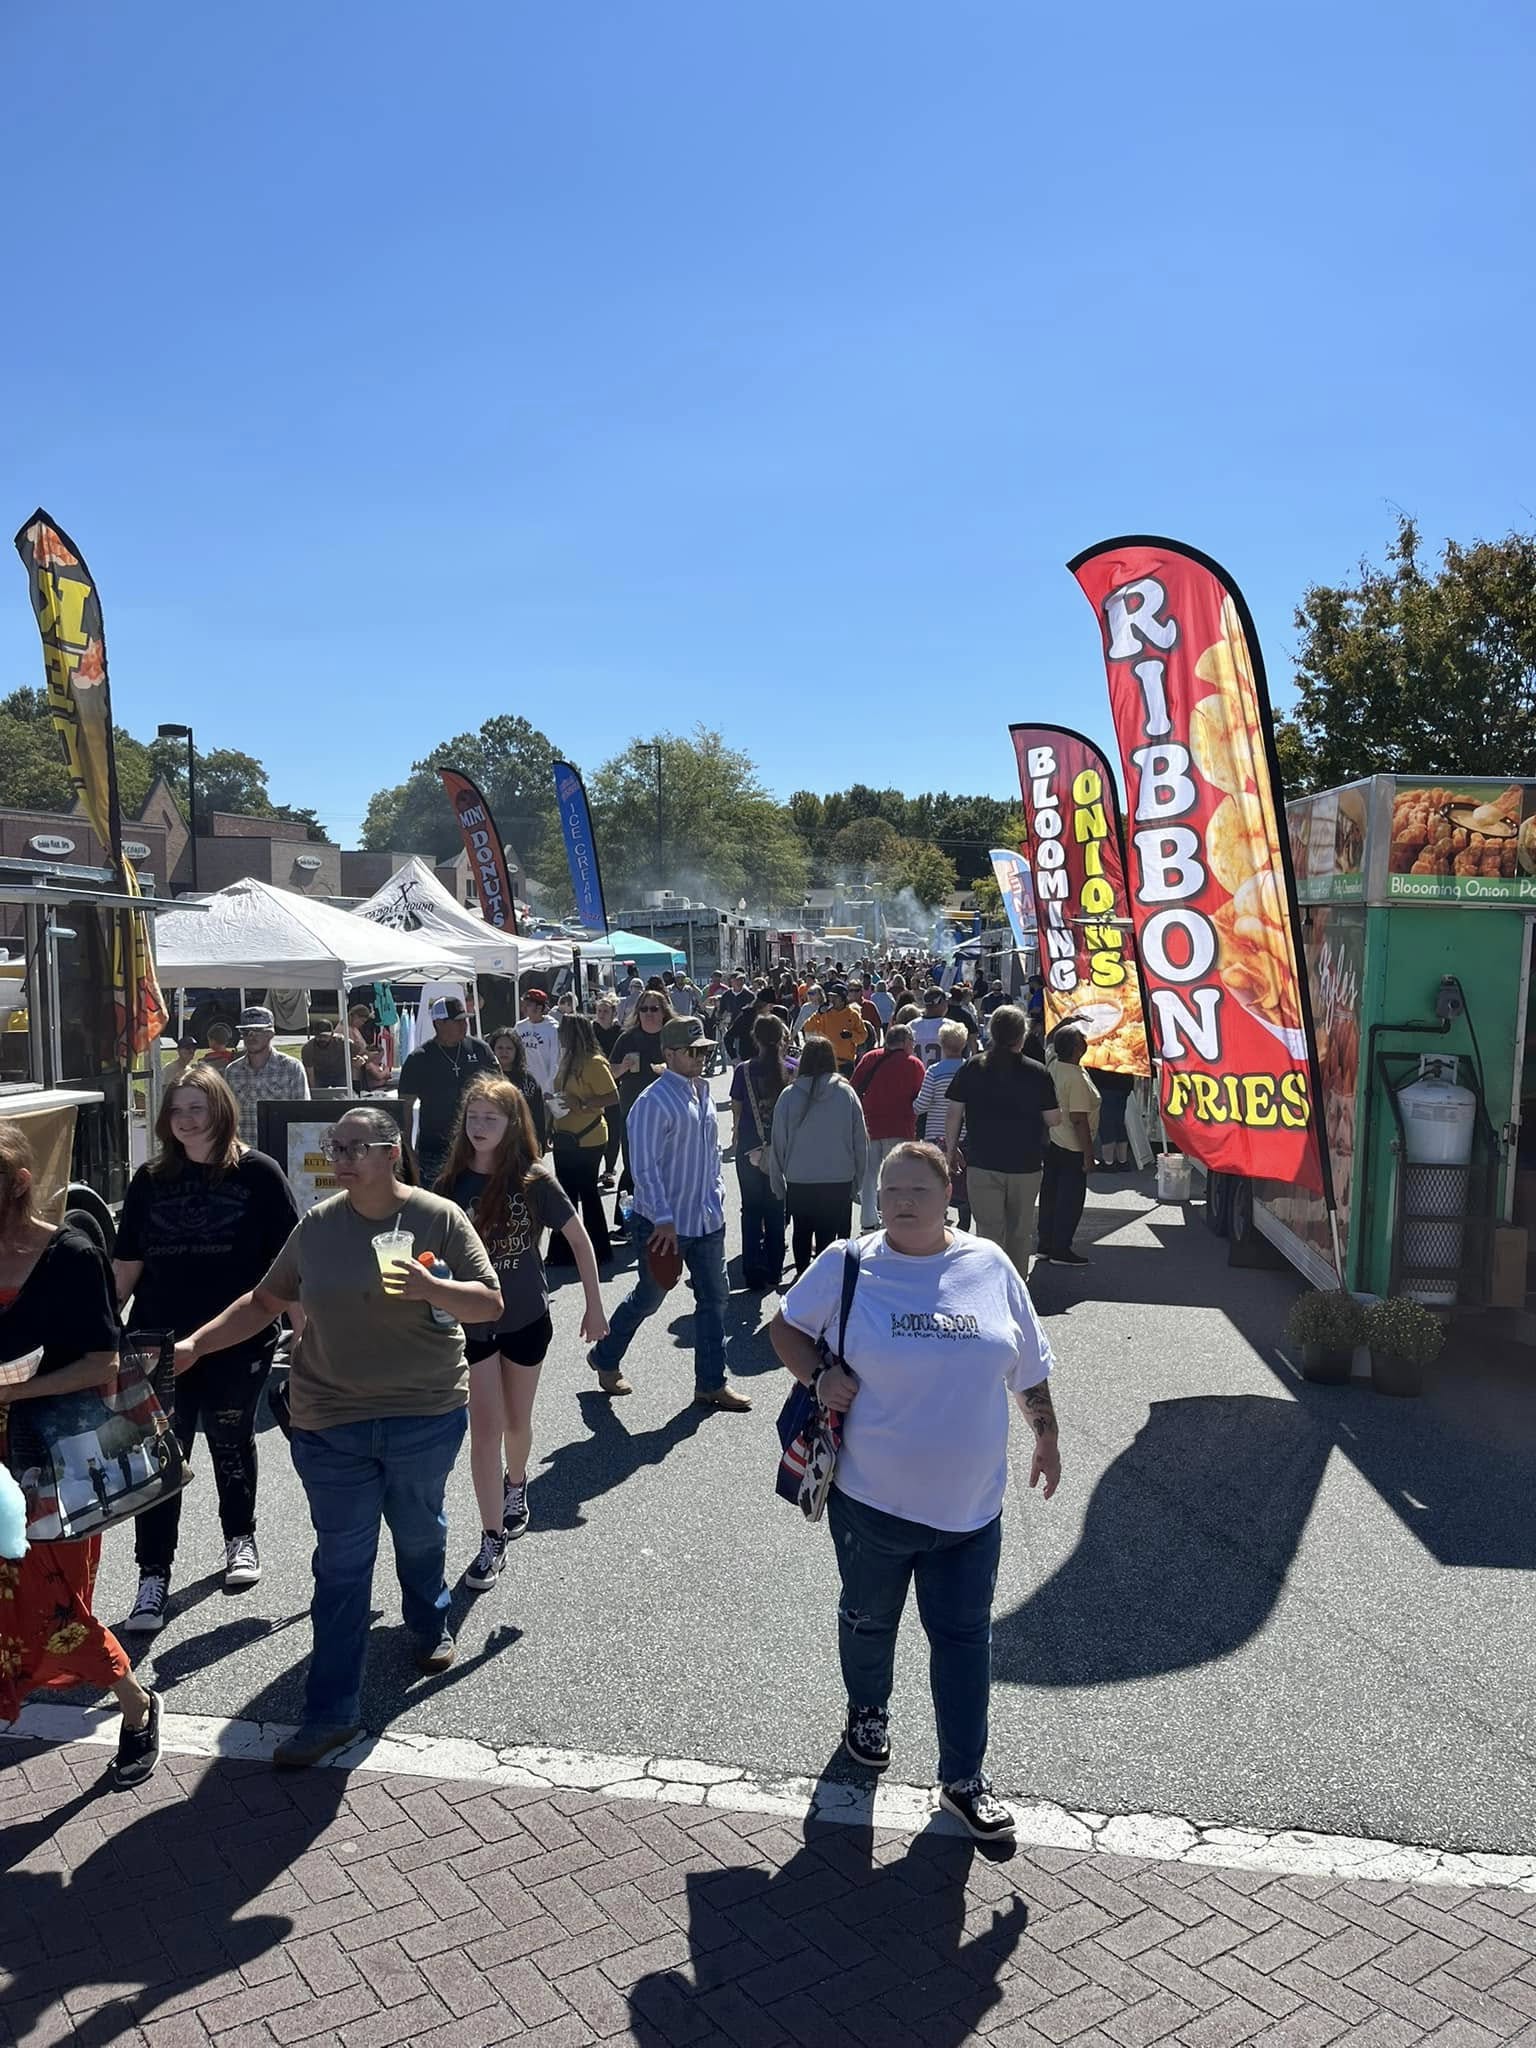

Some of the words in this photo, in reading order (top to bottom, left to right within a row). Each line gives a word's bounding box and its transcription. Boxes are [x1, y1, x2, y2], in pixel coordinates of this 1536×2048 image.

[459, 805, 485, 829] MINI
[569, 803, 582, 839] ICE
[1106, 578, 1222, 1063] RIBBON
[470, 831, 504, 928] DONUTS
[1027, 746, 1078, 991] BLOOMING
[1073, 769, 1126, 987] ONIONS
[1391, 877, 1461, 900] Bloooming
[1465, 880, 1509, 897] Onion
[403, 903, 434, 912] HOUND
[1167, 1072, 1310, 1127] FRIES
